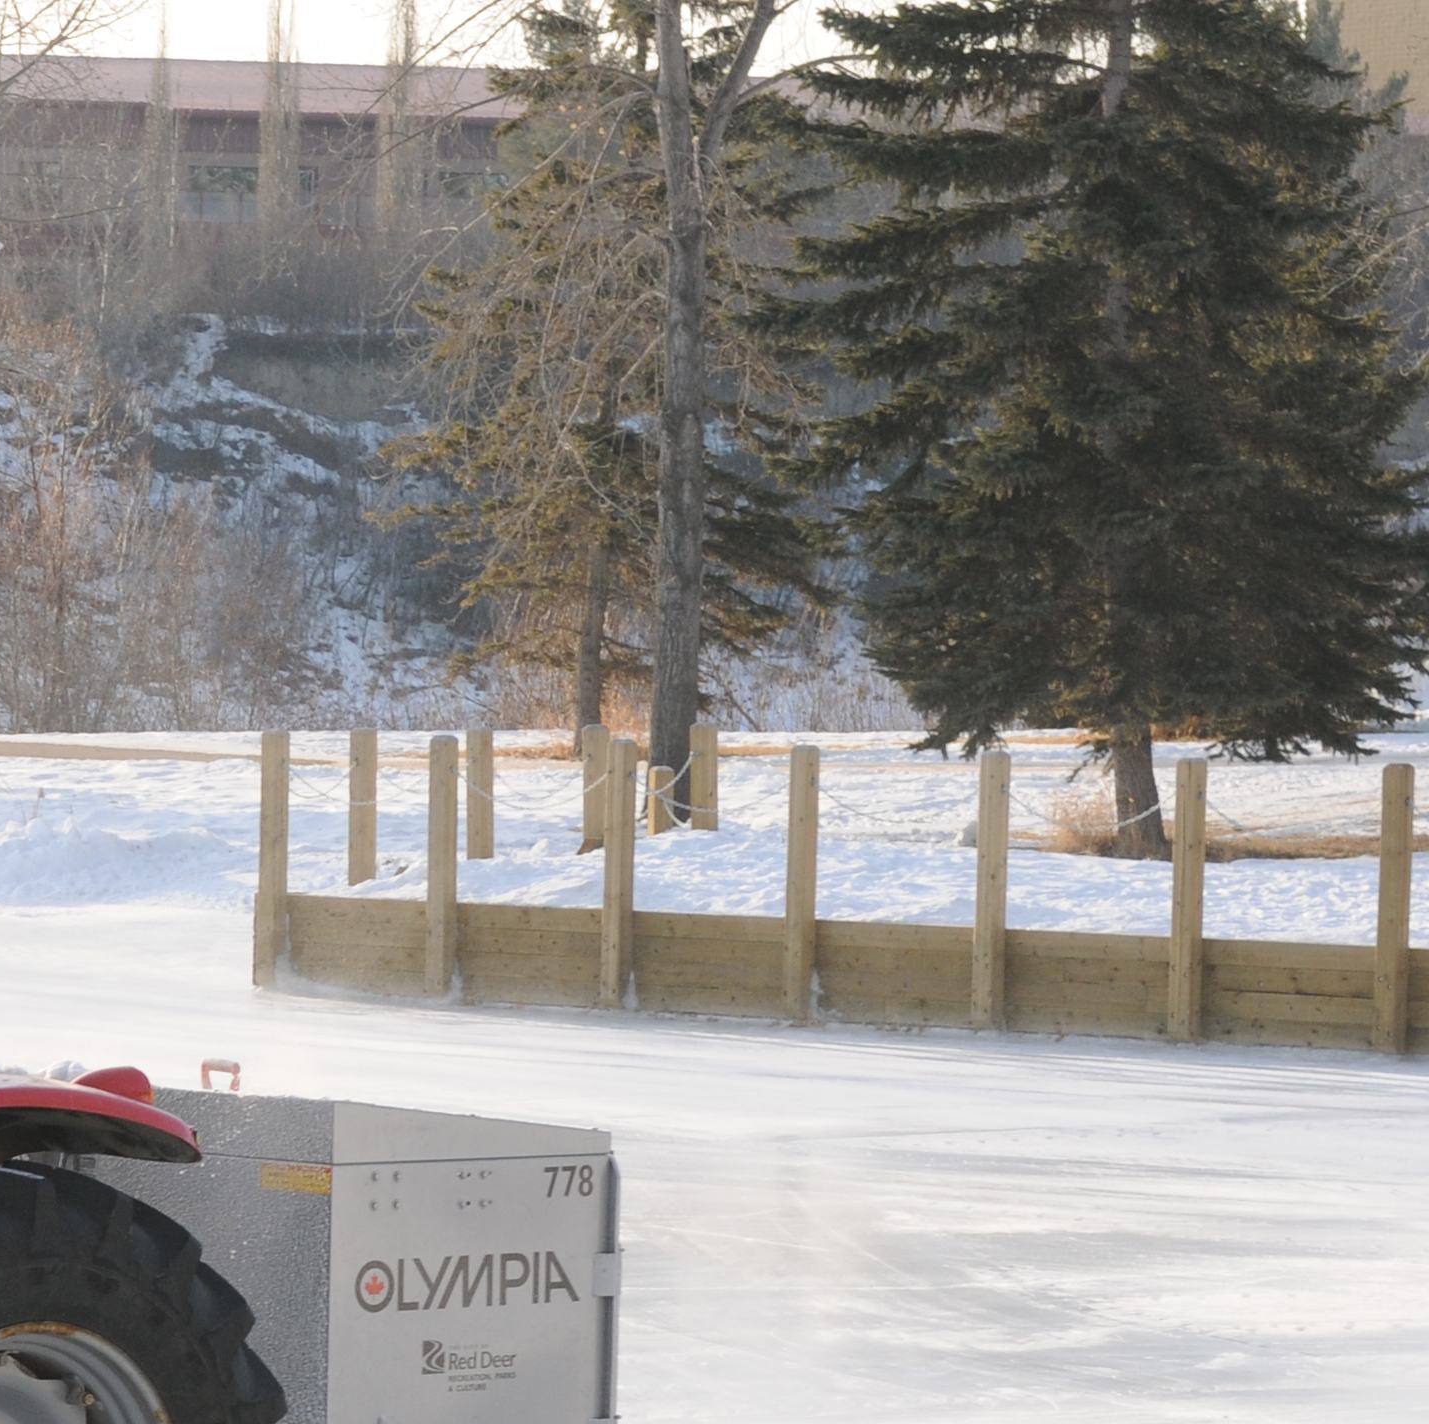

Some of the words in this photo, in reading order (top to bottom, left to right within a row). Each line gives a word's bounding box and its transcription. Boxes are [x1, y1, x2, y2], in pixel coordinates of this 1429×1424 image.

[543, 1165, 594, 1198] 778
[355, 1251, 580, 1313] OLYMPIA
[448, 1352, 477, 1370] Red
[481, 1351, 516, 1368] Deer
